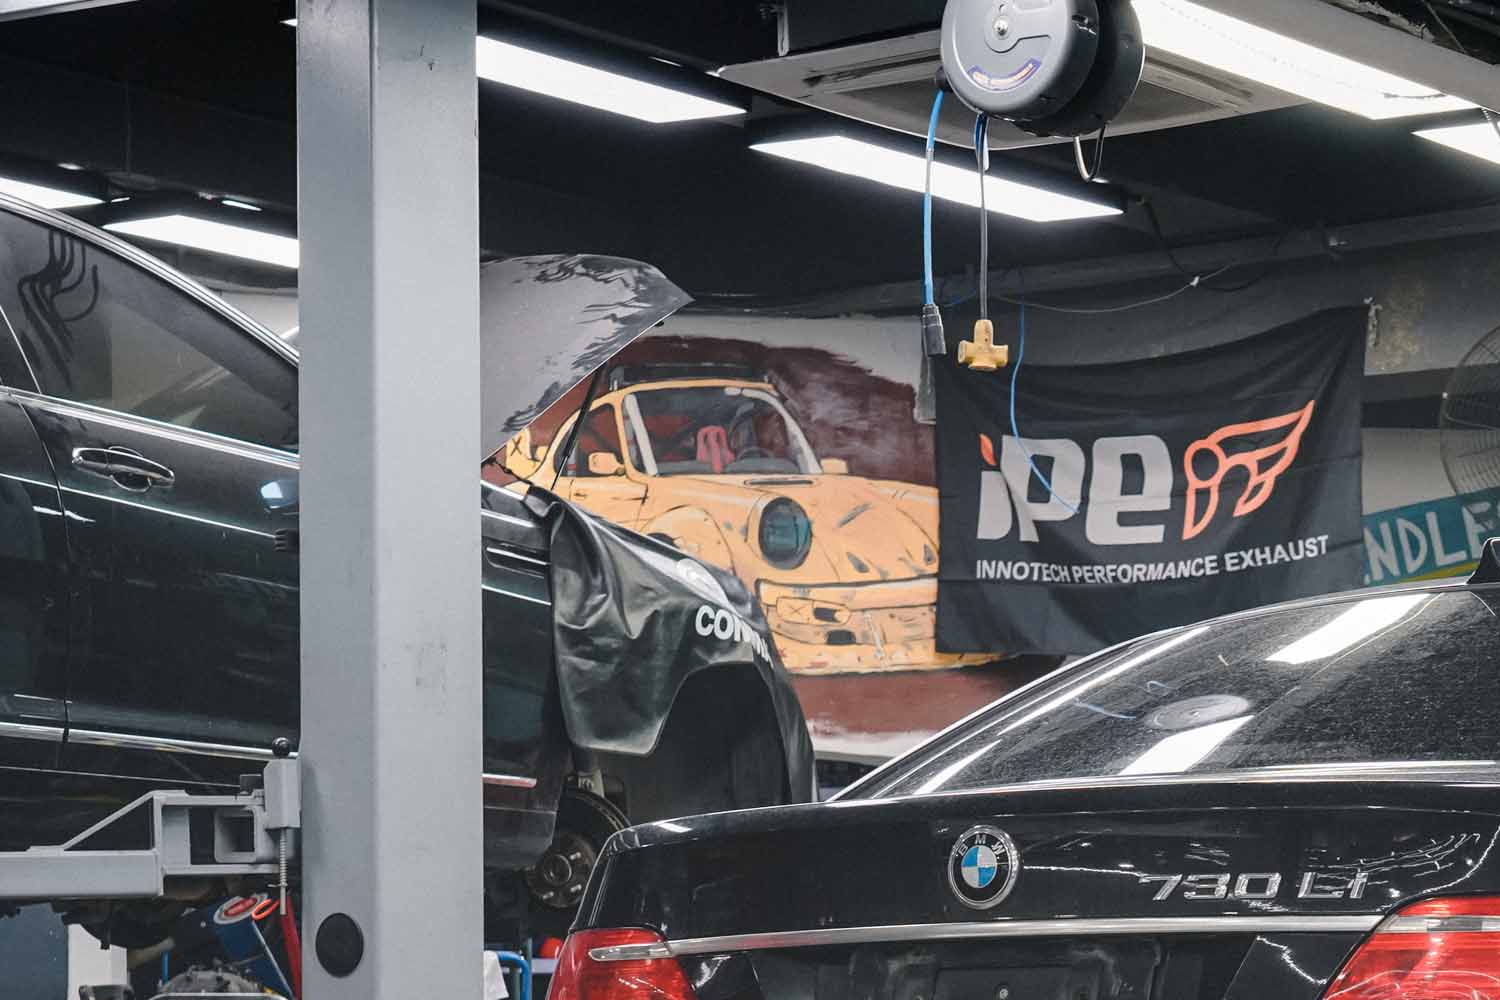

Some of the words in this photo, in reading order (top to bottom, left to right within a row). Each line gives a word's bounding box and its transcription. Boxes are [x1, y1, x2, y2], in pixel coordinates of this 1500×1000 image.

[976, 559, 1071, 584] INNOTECH
[1072, 555, 1219, 585] PERFORMANCE
[1225, 535, 1329, 572] EXHAUST
[958, 834, 1006, 857] BMW
[1139, 872, 1282, 901] 730
[1298, 871, 1369, 899] Li
